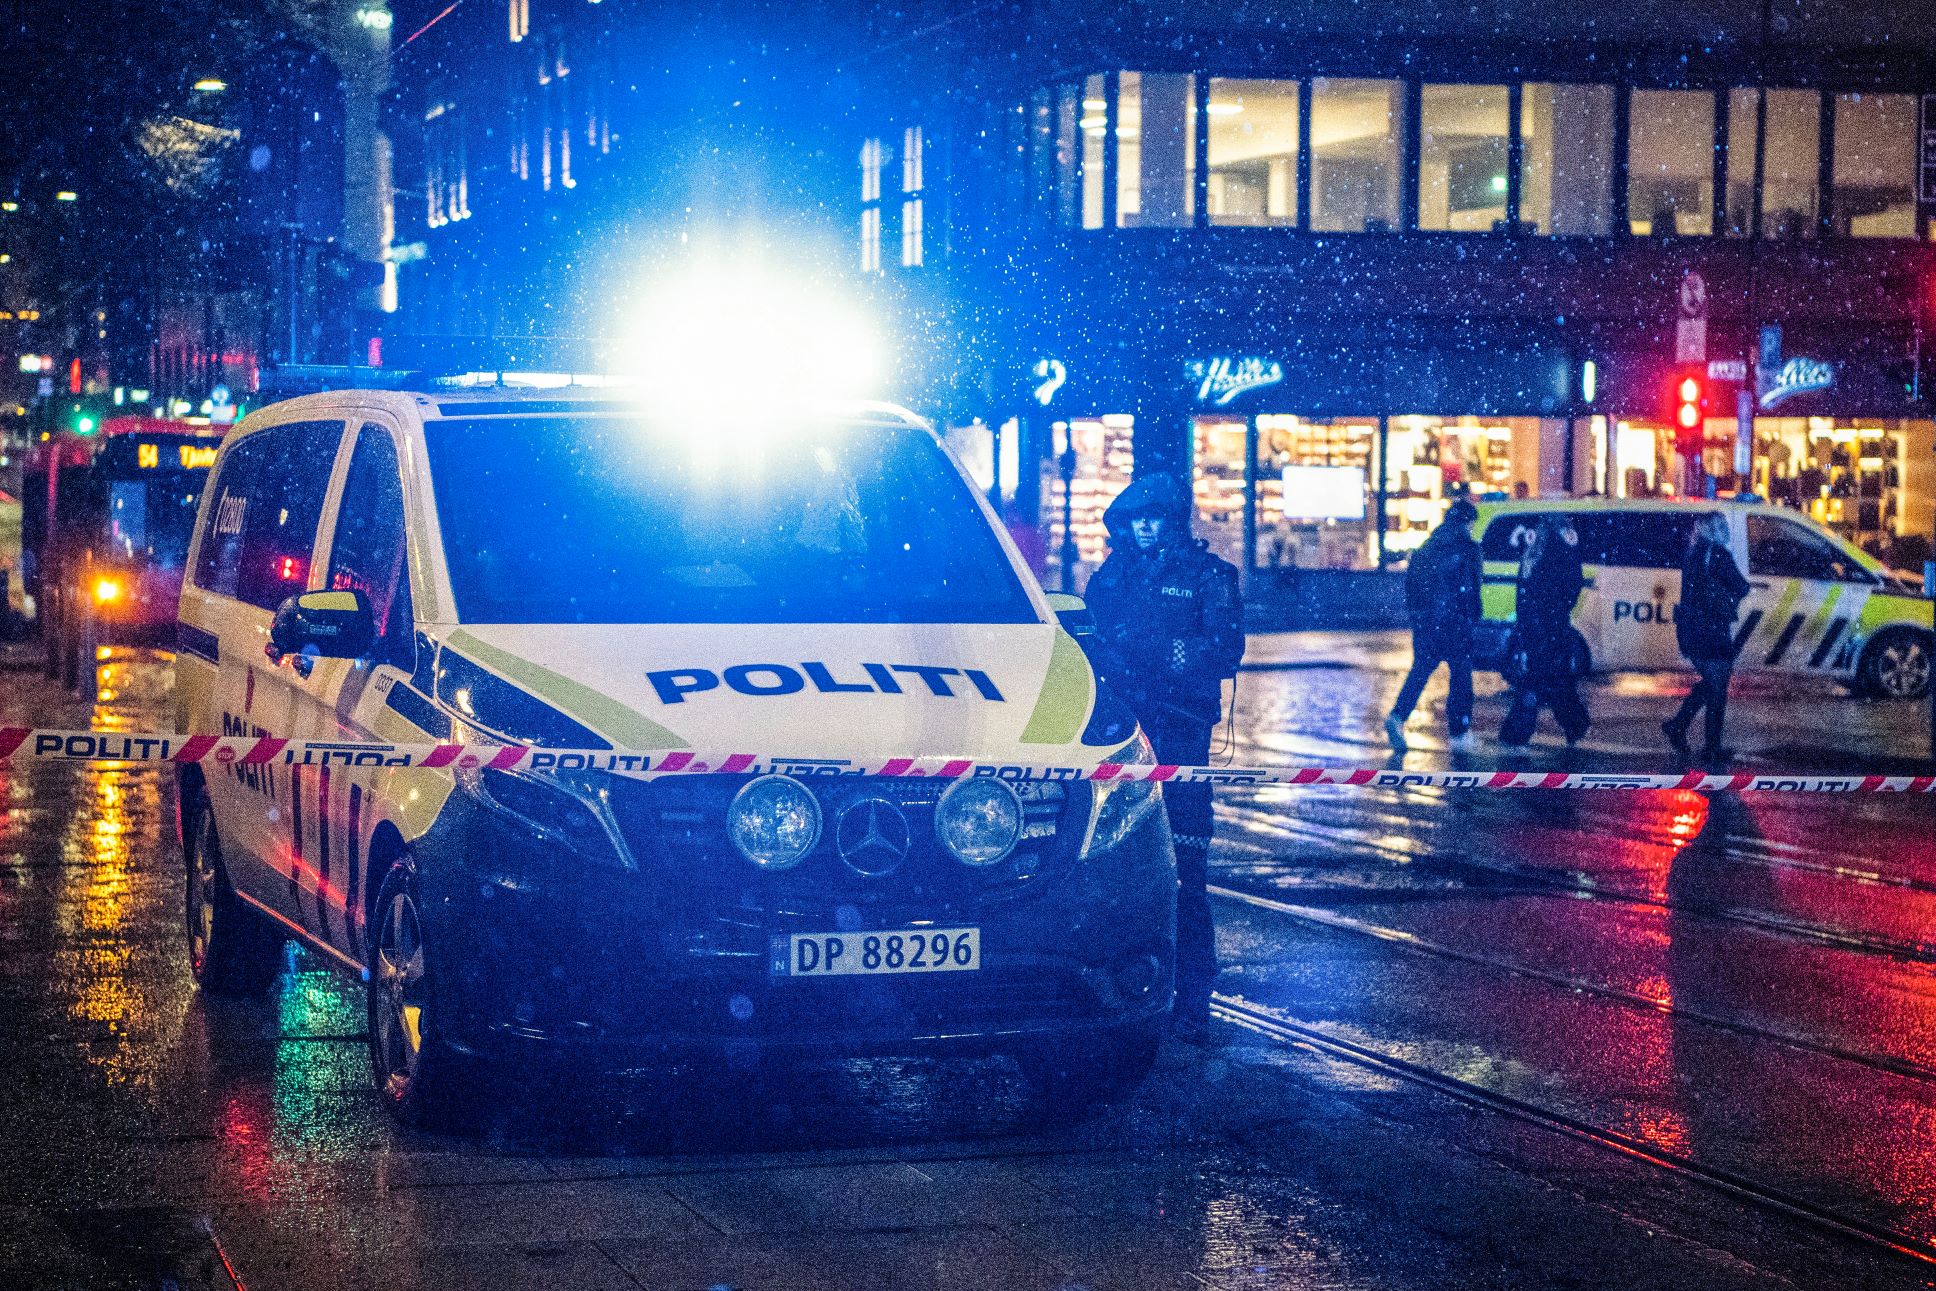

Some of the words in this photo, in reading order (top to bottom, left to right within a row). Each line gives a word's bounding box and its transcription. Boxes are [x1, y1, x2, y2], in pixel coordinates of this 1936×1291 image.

[1161, 586, 1193, 598] POLITI
[1613, 601, 1670, 624] POL
[645, 661, 1005, 705] POLITI
[35, 734, 170, 760] POLITI
[530, 752, 651, 771] POLITI
[971, 765, 1083, 781] POLITI
[797, 937, 844, 972] DP
[861, 932, 973, 970] 88296
